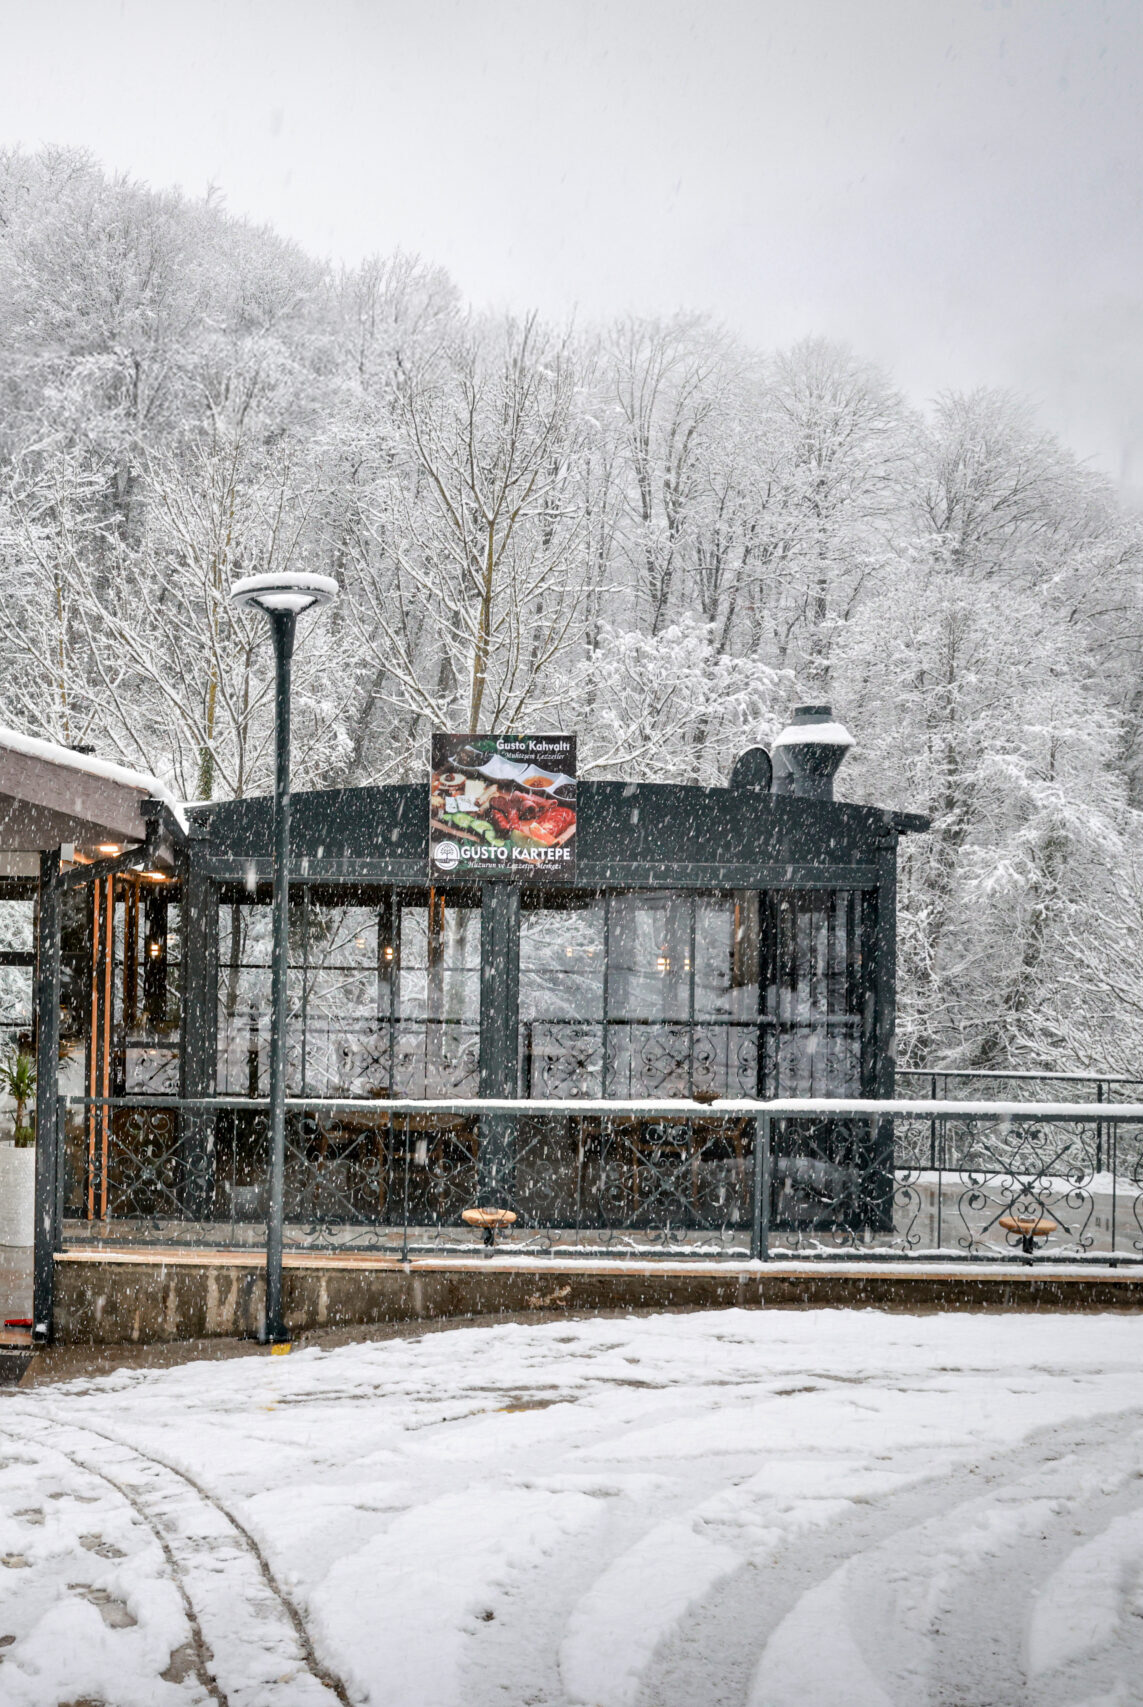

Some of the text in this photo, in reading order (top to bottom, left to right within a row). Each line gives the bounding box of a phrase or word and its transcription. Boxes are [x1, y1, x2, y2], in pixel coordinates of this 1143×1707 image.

[496, 740, 570, 751] Gusto Kahvaltı
[461, 846, 570, 860] GUSTO KARTEPE
